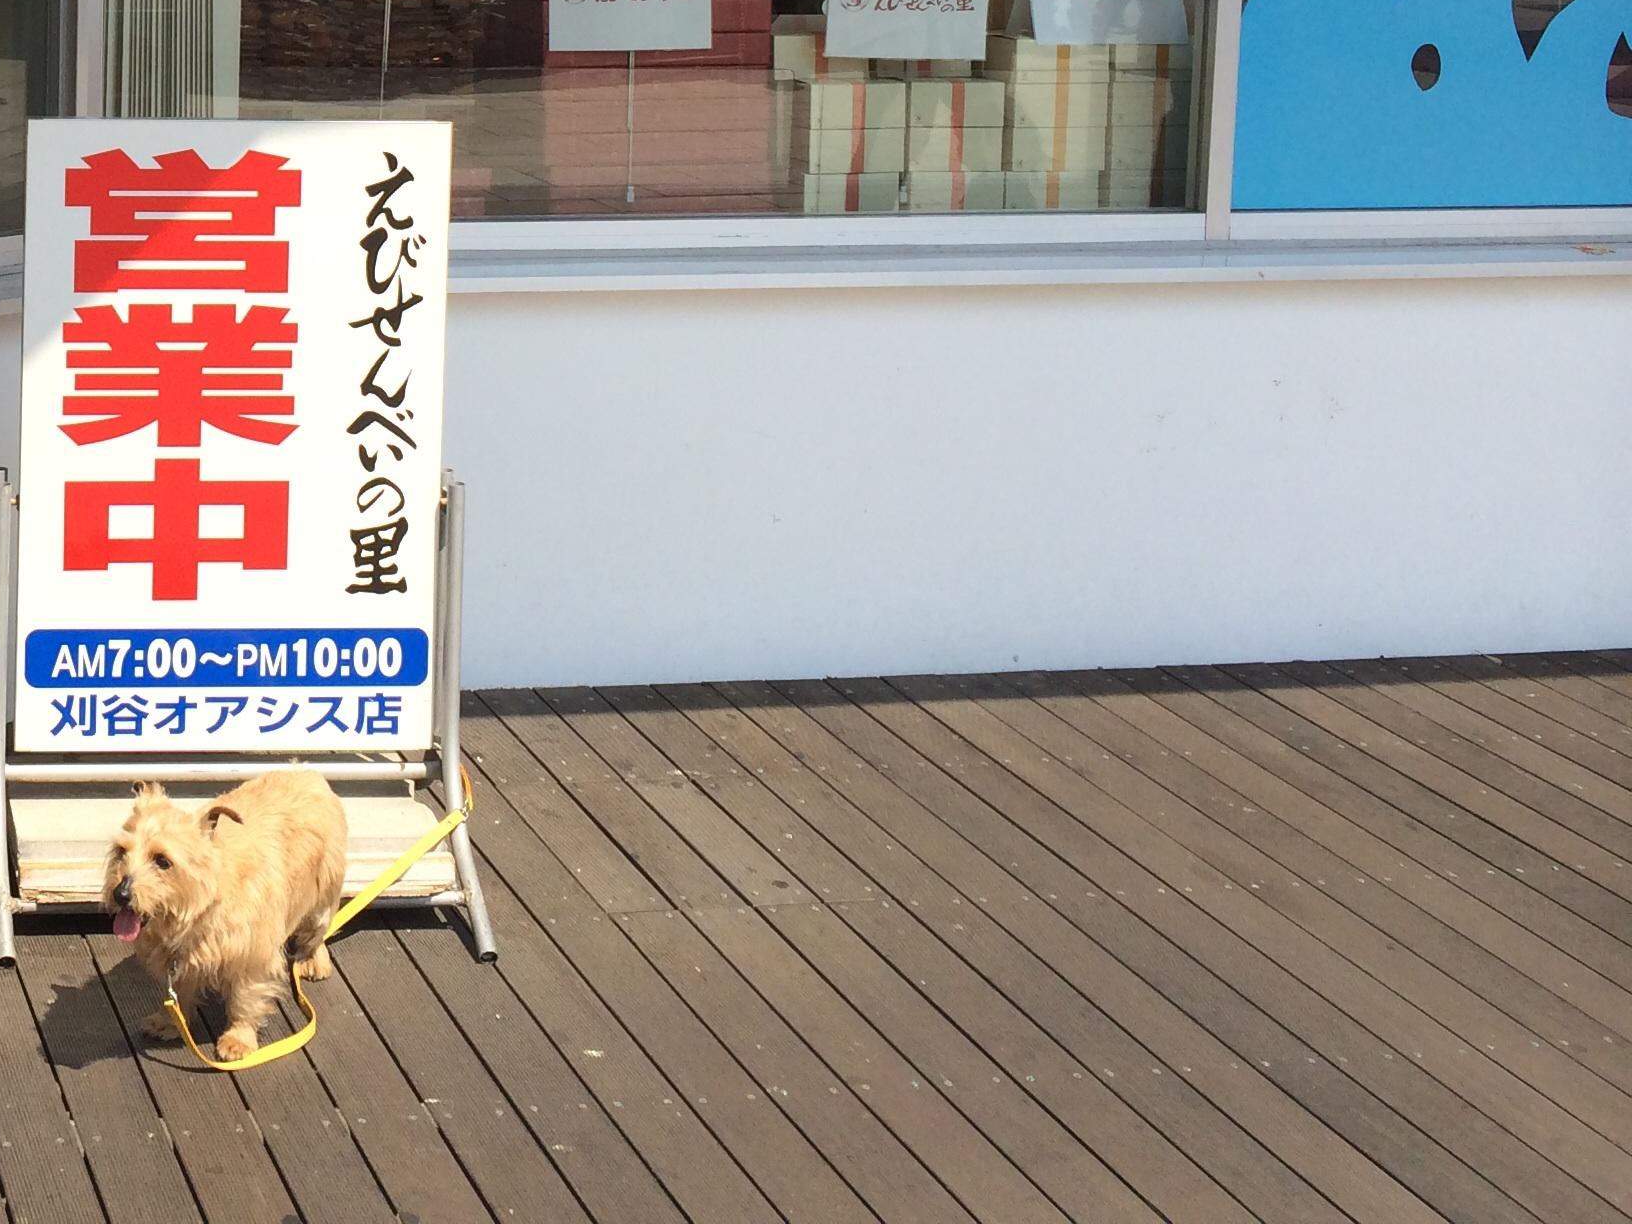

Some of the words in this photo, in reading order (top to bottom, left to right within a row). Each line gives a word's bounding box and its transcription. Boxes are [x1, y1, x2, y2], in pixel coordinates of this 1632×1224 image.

[58, 148, 302, 602] 営業中
[345, 151, 425, 595] えびせんべいの里
[50, 693, 402, 738] 刈谷オアシス店
